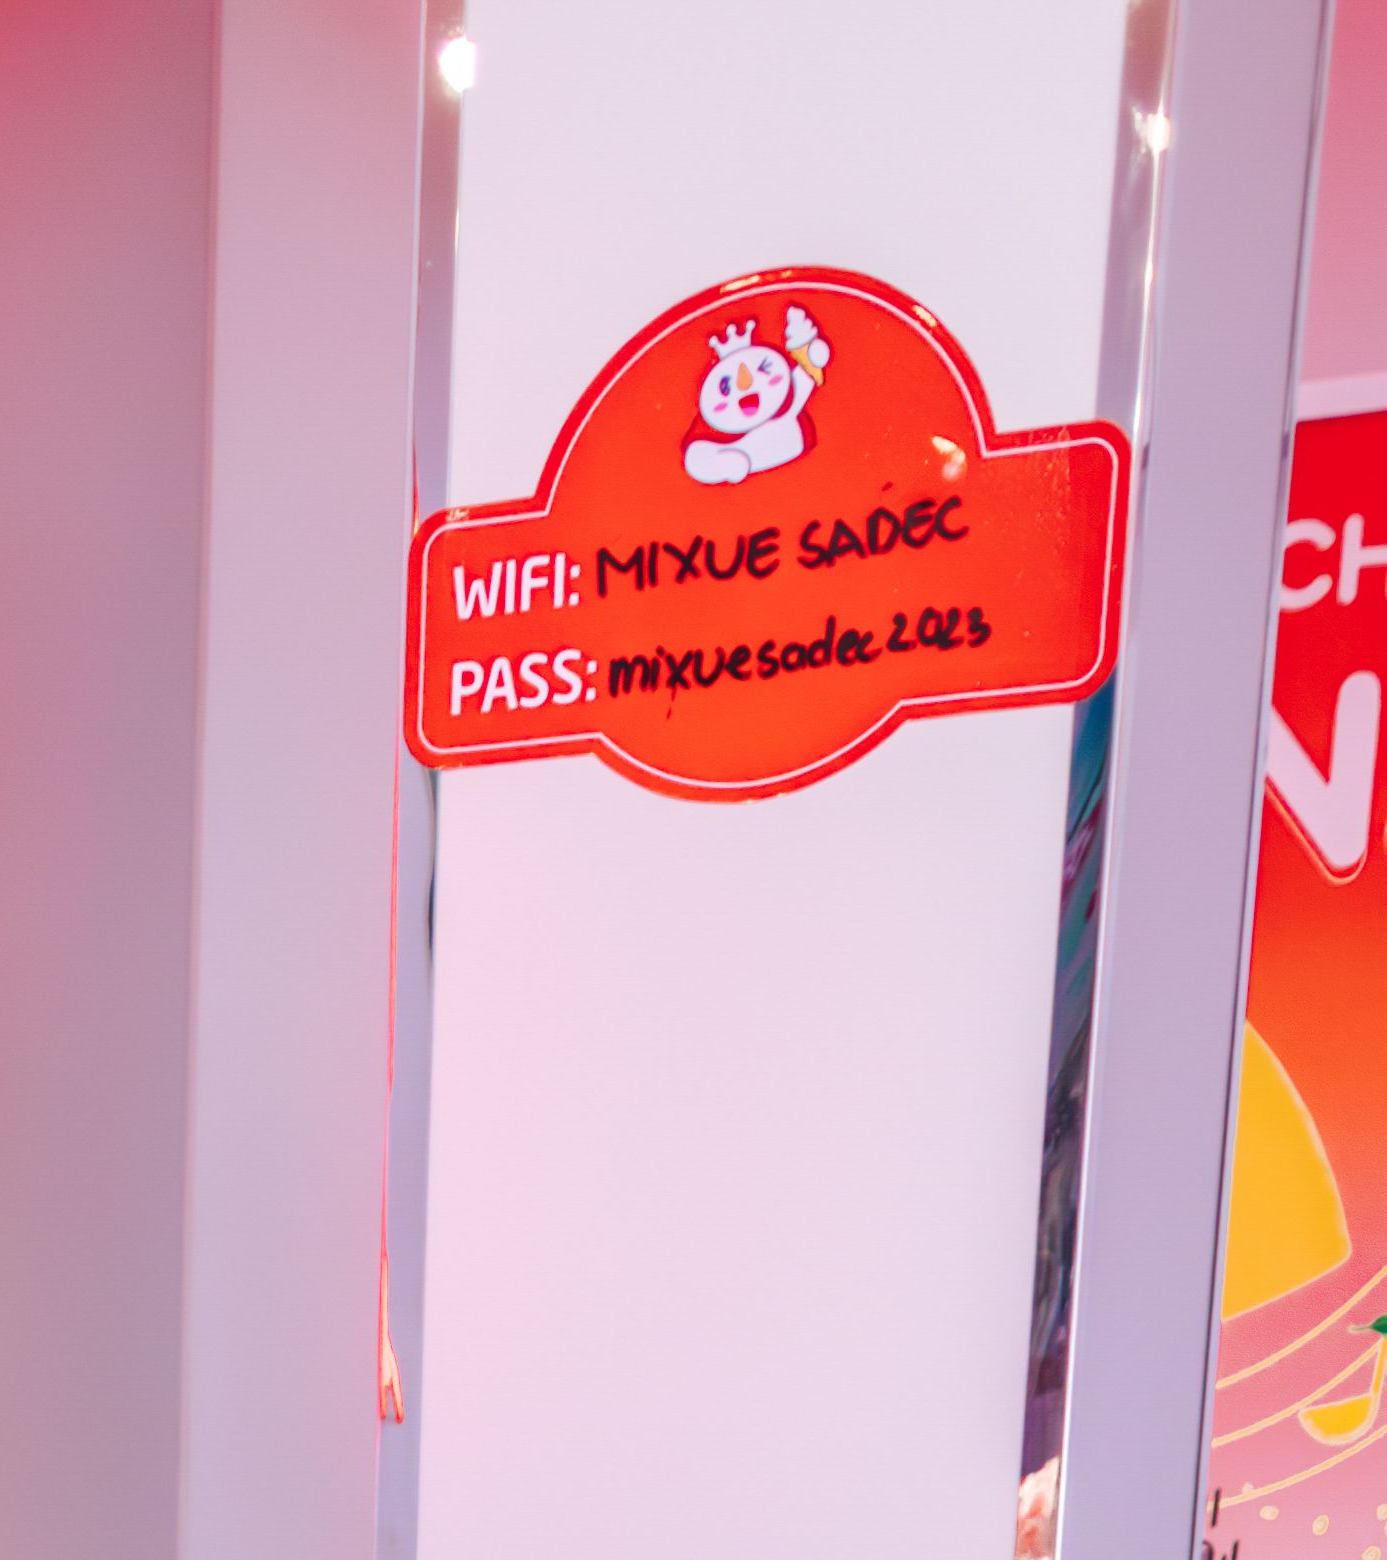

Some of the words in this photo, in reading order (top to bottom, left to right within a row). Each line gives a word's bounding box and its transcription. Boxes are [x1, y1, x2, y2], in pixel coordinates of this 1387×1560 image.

[453, 552, 581, 622] WIFI:
[596, 527, 780, 598] MIXUE
[450, 648, 597, 717] PASS:
